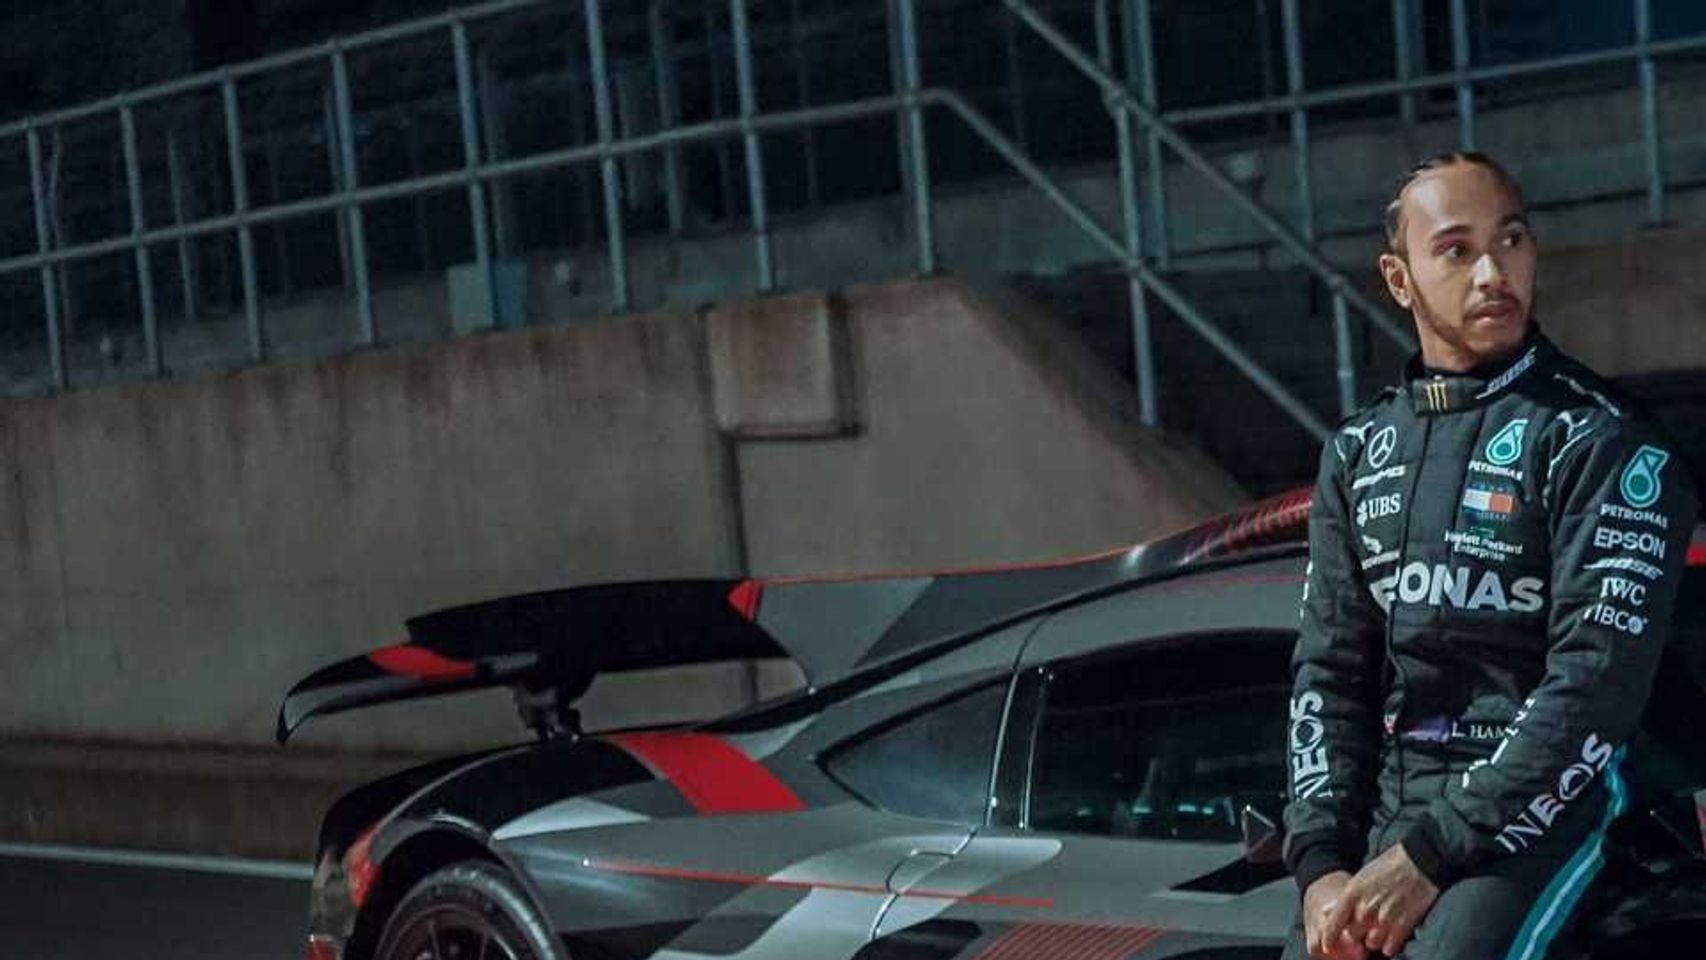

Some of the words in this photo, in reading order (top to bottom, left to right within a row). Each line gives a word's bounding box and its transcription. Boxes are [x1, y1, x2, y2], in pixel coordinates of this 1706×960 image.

[1368, 493, 1401, 519] UBS
[1600, 503, 1668, 530] PETRONAS
[1593, 526, 1666, 560] EPSON
[1600, 577, 1646, 606] IWC
[1494, 732, 1613, 853] INEOS
